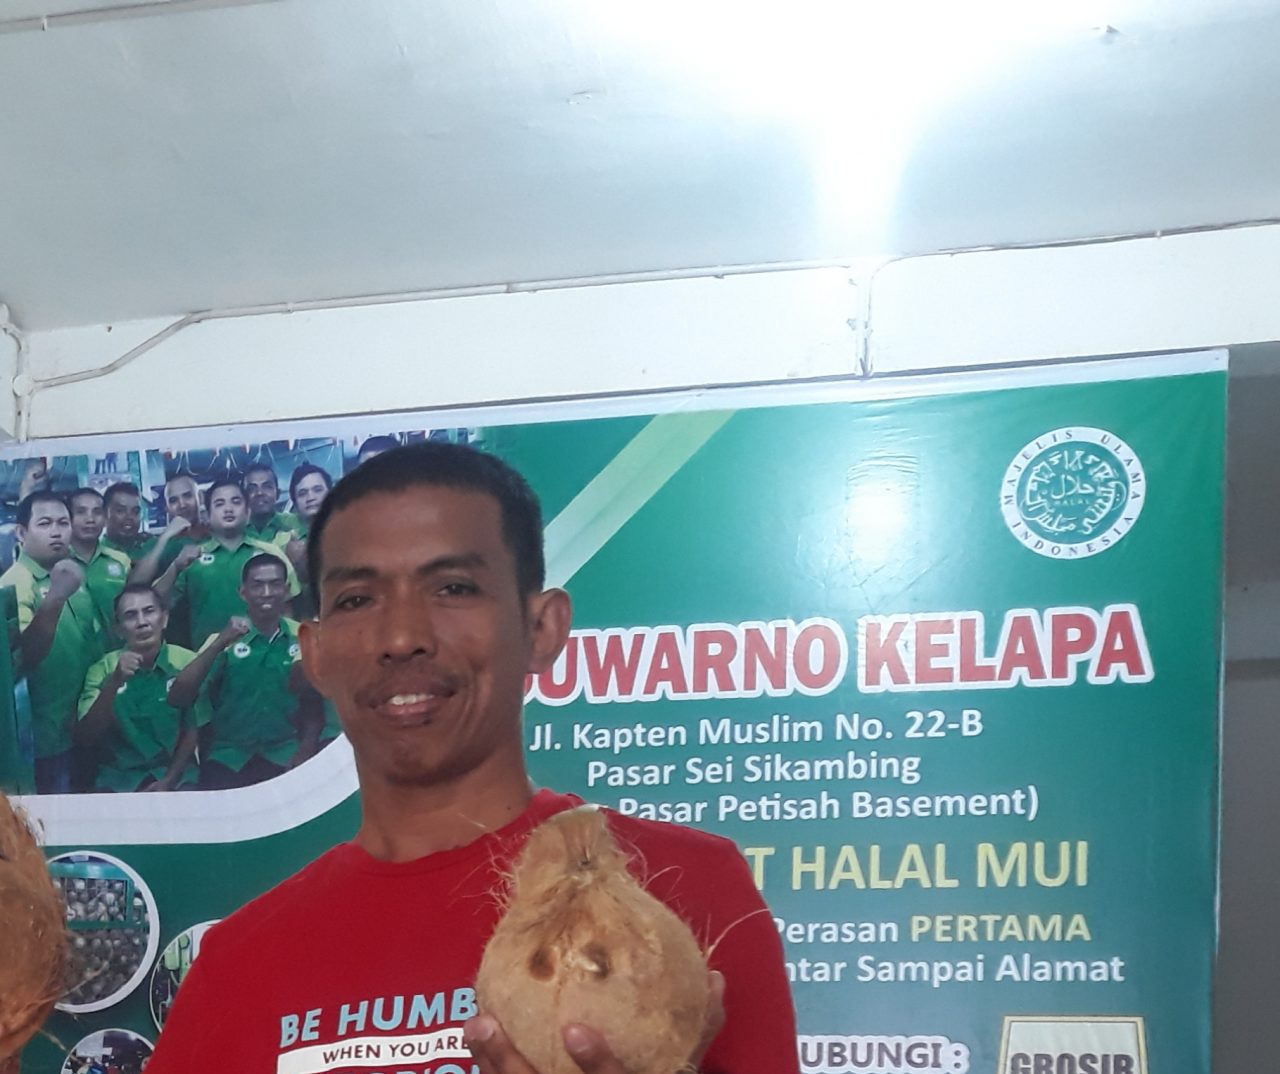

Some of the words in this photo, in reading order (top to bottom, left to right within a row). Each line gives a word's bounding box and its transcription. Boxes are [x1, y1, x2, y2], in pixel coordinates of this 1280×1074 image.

[1004, 431, 1073, 505] MAJELIS
[1100, 434, 1141, 500] ULAMA
[1012, 517, 1134, 556] INDONESIA
[523, 623, 843, 701] UWARNO
[862, 610, 1148, 688] KELAPA
[529, 723, 562, 751] Jl.
[573, 723, 687, 754] Kapten
[698, 716, 822, 745] Muslim
[835, 713, 892, 742] No.
[904, 710, 983, 738] 22-B
[587, 761, 676, 787] Pasar
[685, 755, 732, 784] Sei
[744, 751, 921, 784] Sikambing
[619, 797, 708, 823] Pasar
[720, 790, 839, 822] Petisah
[853, 785, 1040, 820] Basement)
[792, 843, 959, 890] HALAL
[977, 840, 1089, 888] MUI
[910, 914, 1091, 942] PERTAMA
[785, 957, 846, 982] ntar
[857, 954, 984, 988] Sampai
[996, 953, 1125, 982] Alamat
[280, 1008, 322, 1048] BE
[337, 987, 479, 1036] HUMB
[323, 1045, 380, 1064] WHEN
[389, 1041, 430, 1058] YOU
[434, 1035, 470, 1052] ARE
[801, 1042, 943, 1068] UBUNGI
